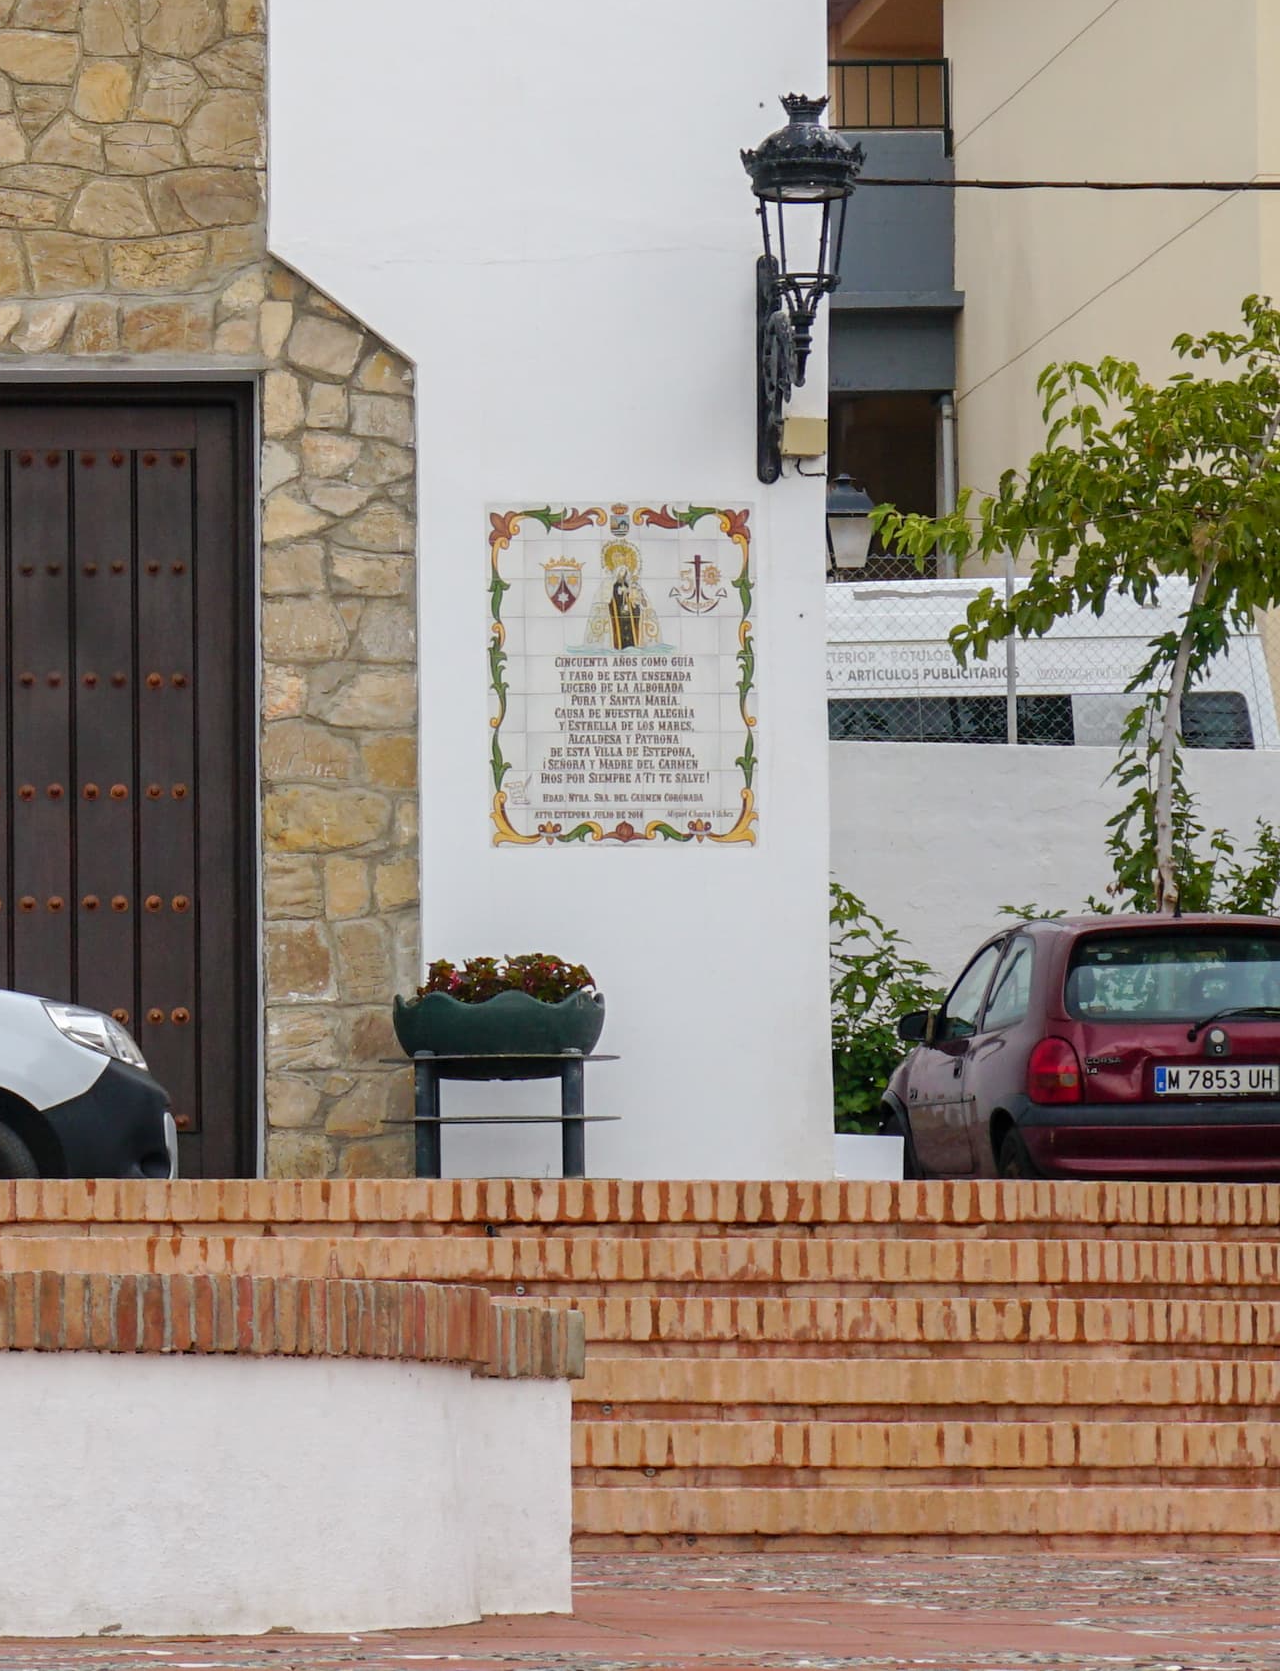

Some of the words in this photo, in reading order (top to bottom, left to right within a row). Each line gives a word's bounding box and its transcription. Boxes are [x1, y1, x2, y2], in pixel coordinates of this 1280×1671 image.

[554, 657, 608, 667] CINCUENTA
[612, 655, 637, 667] AÑOS
[641, 657, 668, 667] COMO
[671, 655, 694, 667] GUÍA
[559, 671, 565, 681] Y
[569, 671, 593, 681] FARO
[598, 671, 609, 681] DE
[613, 671, 637, 681] ESTA
[641, 671, 692, 681] ENSENADA
[560, 683, 597, 693] LUCERO
[601, 683, 613, 693] DE
[617, 683, 629, 693] LA
[633, 683, 684, 693] ALBORADA
[571, 696, 596, 706] PURA
[600, 696, 606, 706] Y
[609, 696, 640, 706] SANTA
[554, 708, 584, 719] CAUSA
[589, 708, 601, 719] DE
[604, 708, 649, 719] NUESTRA
[653, 706, 695, 719] ALEGRÍA
[559, 721, 565, 731] Y
[568, 721, 617, 731] ESTRELLA
[621, 721, 633, 731] DE
[637, 721, 655, 731] LOS
[568, 734, 621, 745] ALCALDESA
[625, 734, 632, 745] Y
[635, 734, 679, 745] PATRONA
[550, 747, 562, 757] DE
[566, 747, 590, 757] ESTA
[594, 747, 623, 757] VILLA
[626, 747, 639, 757] DE
[643, 747, 695, 758] ESTEPONA,
[589, 759, 596, 769] Y
[599, 759, 633, 769] MADRE
[637, 759, 655, 769] DEL
[658, 759, 698, 769] CARMEN
[541, 773, 563, 783] DIOS
[566, 773, 585, 783] POR
[589, 773, 632, 783] SIEMPRE
[659, 773, 672, 783] TE
[614, 793, 629, 803] DEL
[630, 793, 662, 803] CARMEN
[664, 793, 704, 803] CORONADA
[1168, 1070, 1180, 1089] M
[1188, 1069, 1241, 1090] 7853
[1248, 1069, 1274, 1089] UH
